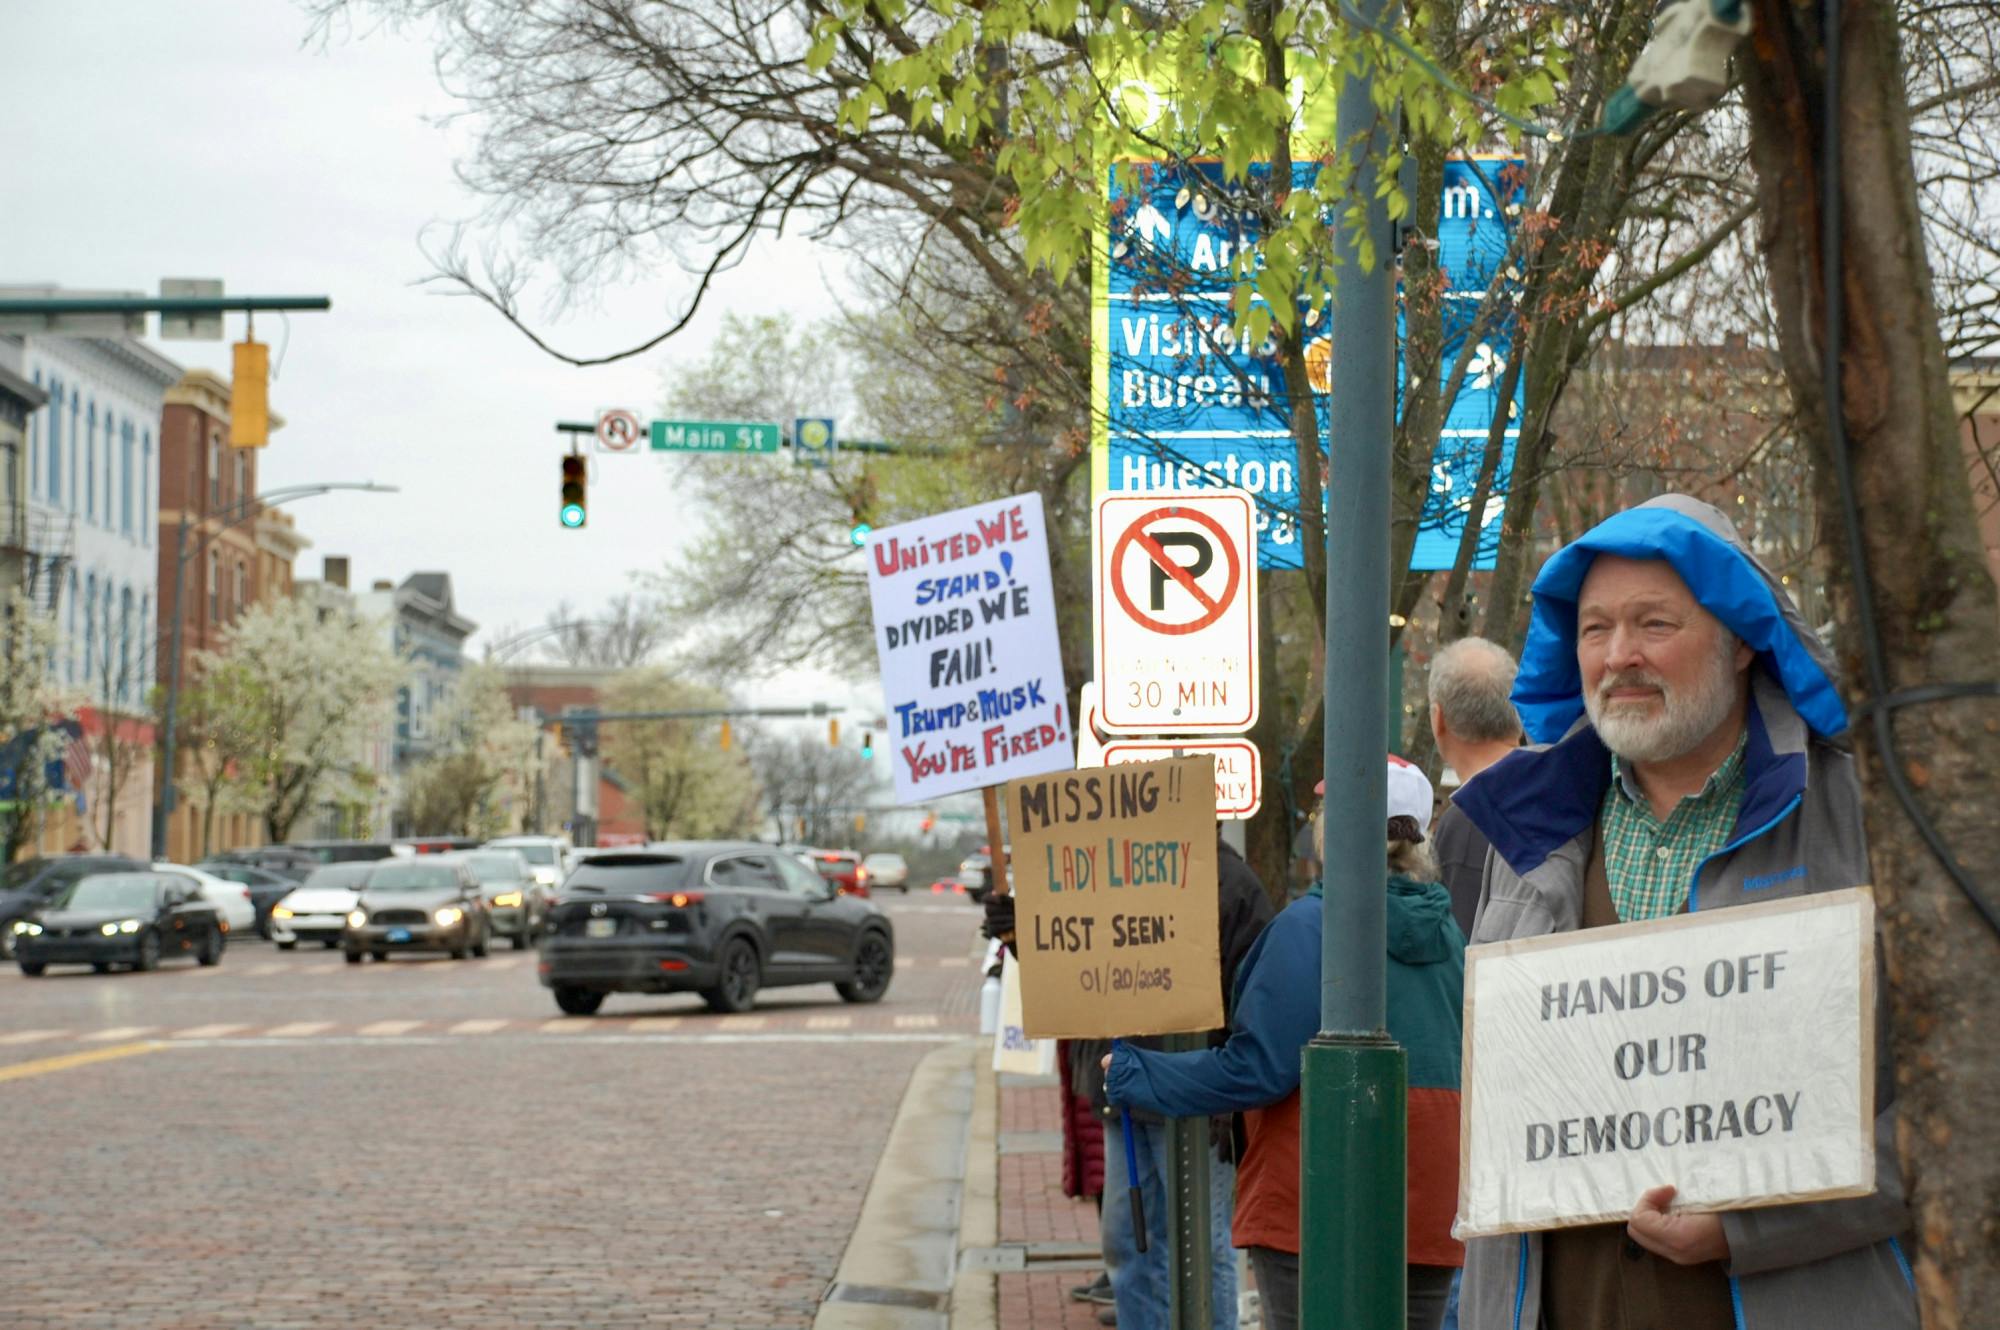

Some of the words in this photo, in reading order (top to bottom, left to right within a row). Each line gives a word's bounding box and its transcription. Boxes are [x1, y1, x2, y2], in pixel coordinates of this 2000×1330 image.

[1122, 369, 1270, 408] Bureau
[664, 424, 727, 448] Main
[735, 426, 764, 449] St
[1122, 453, 1292, 493] Hueston
[886, 608, 974, 650] DIVIDED
[978, 586, 1030, 625] WE
[1128, 681, 1162, 708] 30
[1178, 681, 1228, 708] MIN
[1215, 782, 1247, 800] NLY
[1046, 843, 1097, 893] LADY
[1107, 838, 1191, 889] LIBERTY
[1035, 914, 1095, 952] LAST
[1112, 913, 1175, 948] SEEN:
[1080, 960, 1173, 996] 01/20/2025
[1540, 965, 1687, 1022] HANDS
[1704, 950, 1788, 999] OFF
[1613, 1033, 1707, 1081] OUR
[1525, 1090, 1801, 1162] DEMOCRACY
